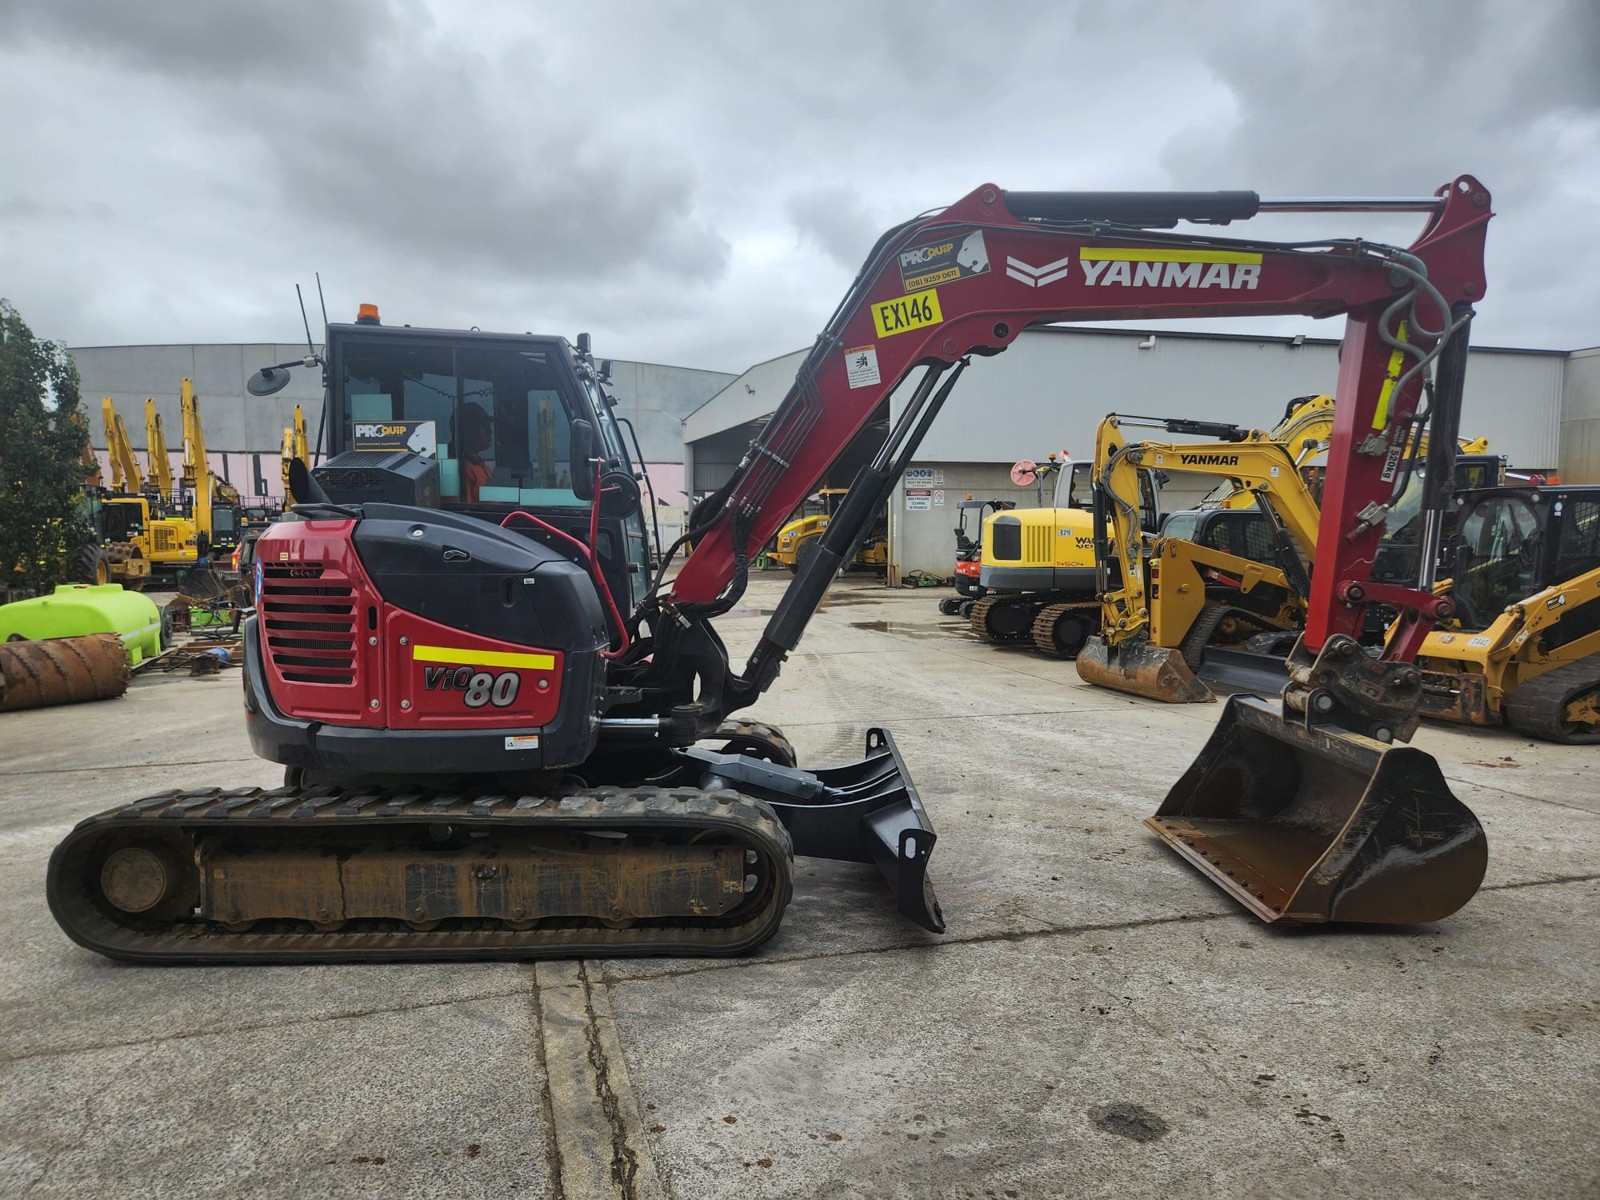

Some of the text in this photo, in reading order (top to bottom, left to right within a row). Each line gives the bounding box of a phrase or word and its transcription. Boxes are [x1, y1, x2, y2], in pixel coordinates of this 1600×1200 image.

[908, 279, 923, 288] (08)
[1079, 260, 1261, 289] YANMAR
[880, 296, 933, 332] EX146
[355, 424, 407, 438] PROQUIP
[1180, 454, 1239, 466] YANMAR
[1383, 449, 1399, 479] 520kg
